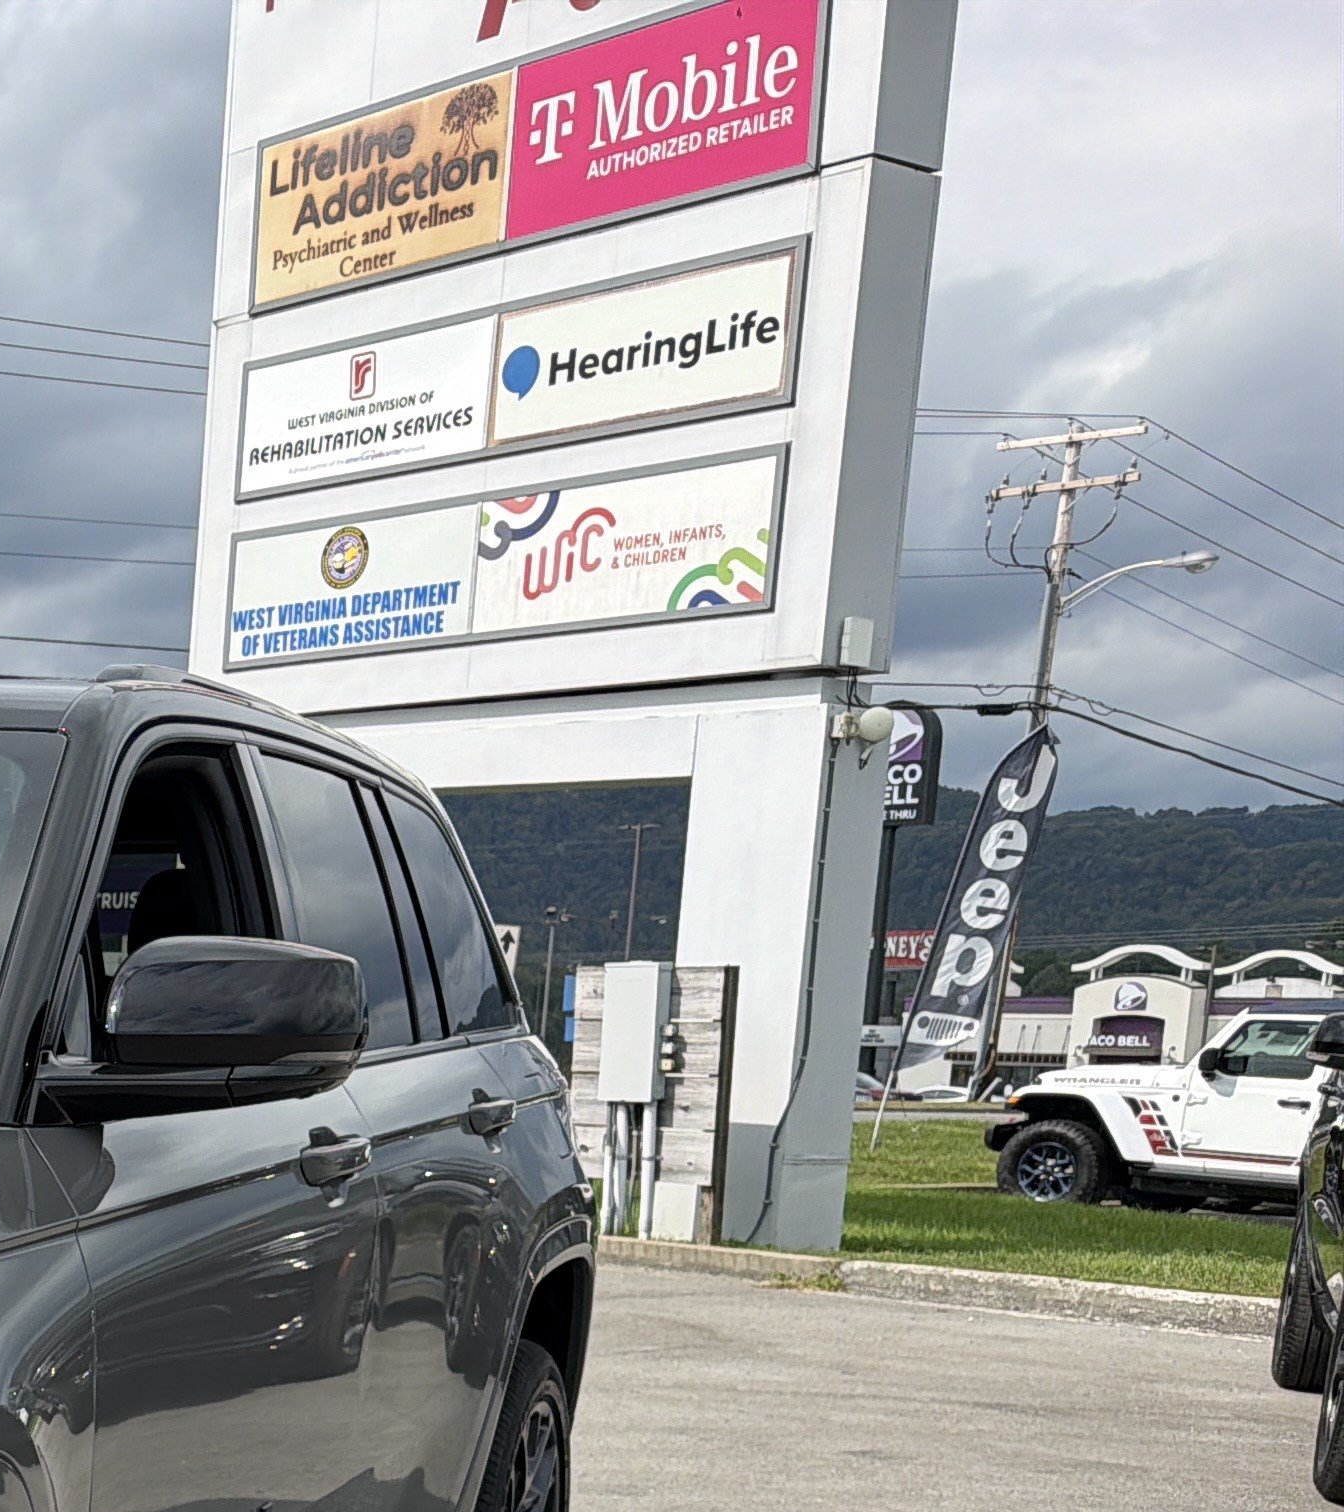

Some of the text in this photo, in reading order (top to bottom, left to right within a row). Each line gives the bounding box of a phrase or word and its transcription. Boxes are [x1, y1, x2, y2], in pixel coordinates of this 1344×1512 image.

[588, 34, 798, 150] Mobile
[269, 123, 415, 197] Lifeline
[585, 105, 795, 181] AUTHORIZED RETAILER
[292, 149, 499, 236] Addiction
[272, 201, 474, 273] Psychiatric and Wellness
[339, 250, 397, 278] Center
[547, 310, 780, 386] HearingLife
[288, 390, 435, 430] WEST VIRGINIA DIVISION OF
[249, 424, 387, 466] REHABILITATION
[392, 406, 474, 440] SERVICES
[611, 547, 687, 569] & CHILDREN
[614, 523, 727, 552] WOMEN, INFANTS,
[233, 580, 461, 632] WEST VIRGINIA DEPARTMENT
[241, 610, 445, 657] OF VETERANS ASSISTANCE
[884, 785, 920, 806] ELL
[887, 763, 923, 785] CO
[889, 809, 917, 820] THRU
[931, 743, 1057, 998] Jeep
[97, 891, 141, 910] RUIS
[1087, 1034, 1151, 1047] ACO BELL
[1054, 1077, 1141, 1086] WRANGLER
